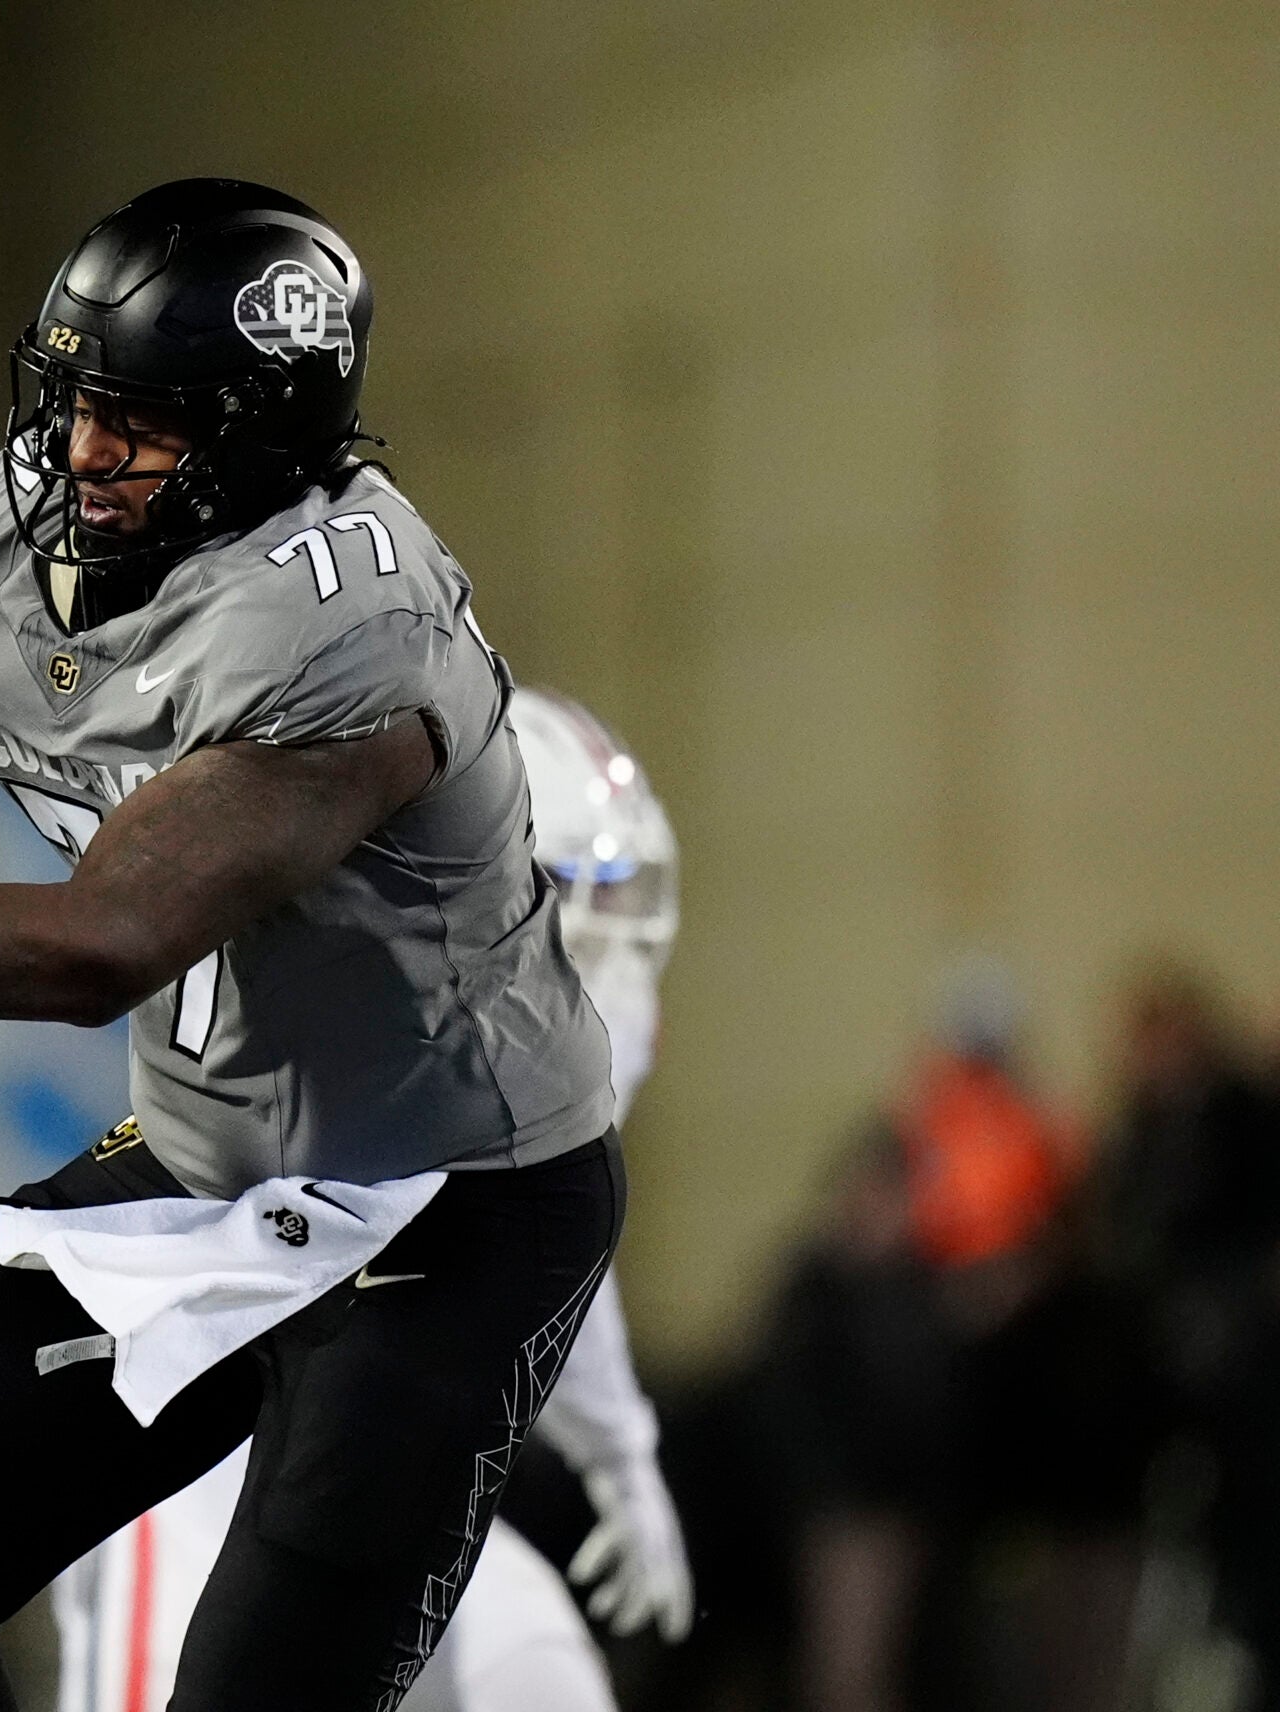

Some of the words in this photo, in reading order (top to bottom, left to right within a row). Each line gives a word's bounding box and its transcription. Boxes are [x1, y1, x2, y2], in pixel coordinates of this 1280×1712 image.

[274, 274, 327, 345] CU
[265, 511, 400, 605] 77
[46, 652, 81, 695] CU
